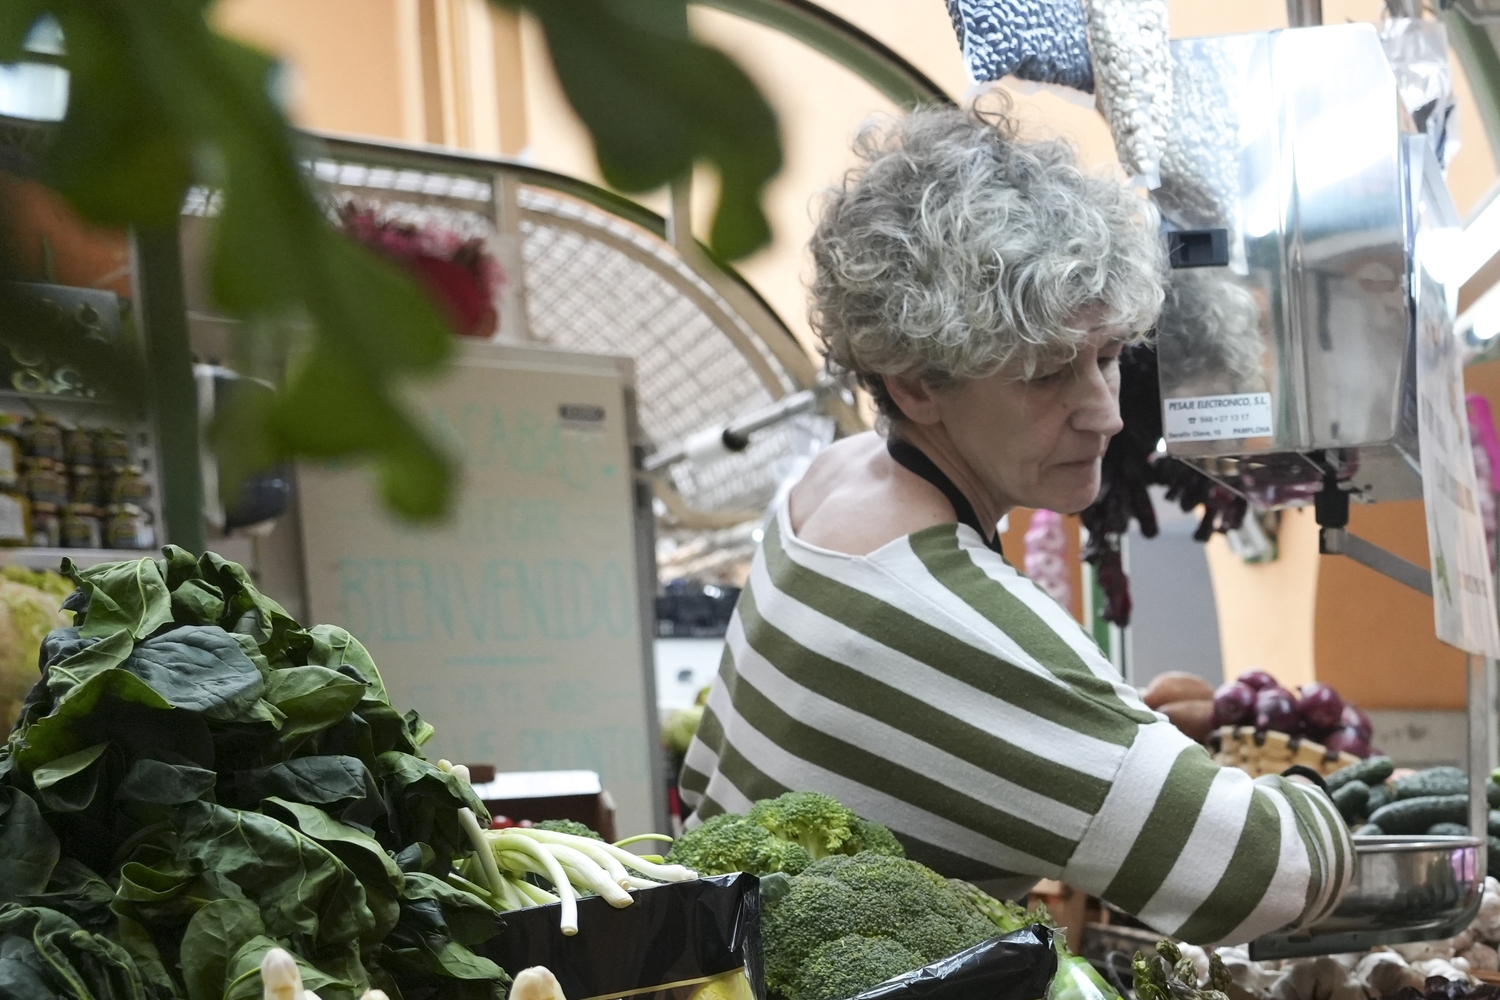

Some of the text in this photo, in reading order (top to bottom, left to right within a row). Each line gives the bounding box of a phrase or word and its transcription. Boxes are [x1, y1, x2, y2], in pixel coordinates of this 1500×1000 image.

[1168, 400, 1196, 411] PESAJE
[1233, 426, 1271, 434] PAMPLONA
[339, 557, 634, 644] BIENVENIDO
